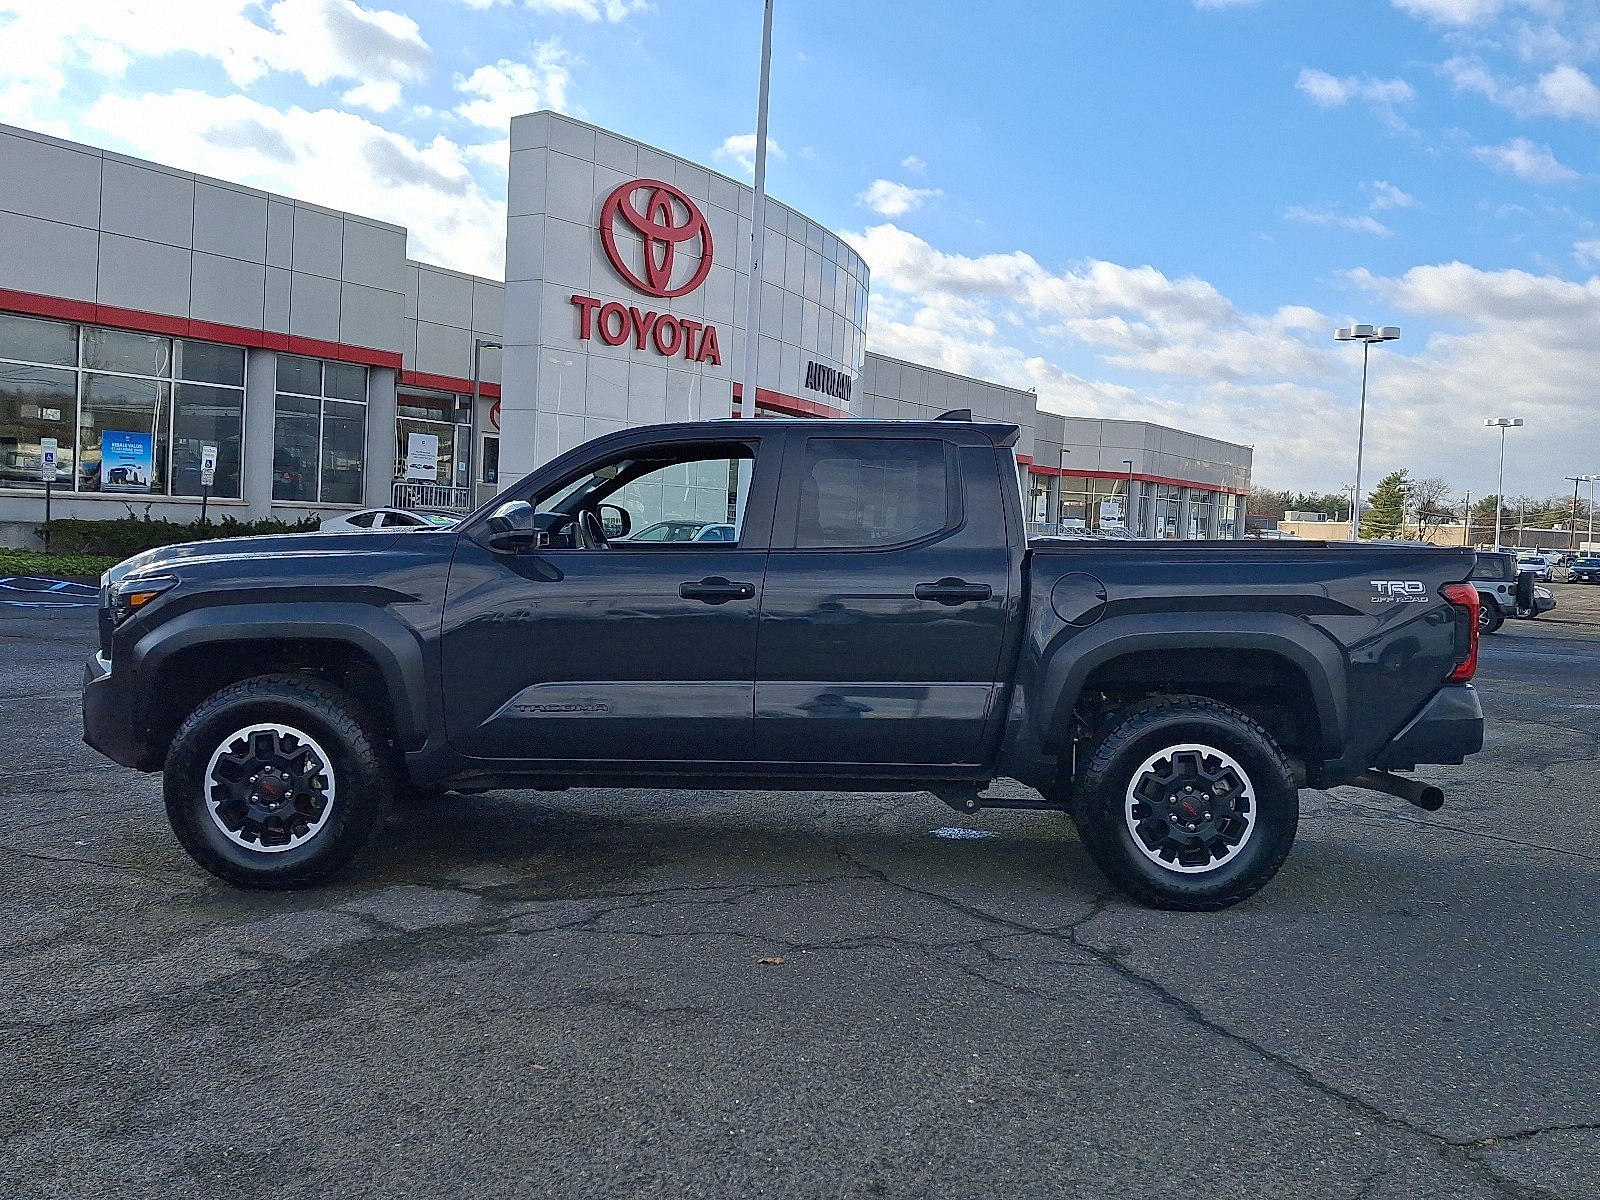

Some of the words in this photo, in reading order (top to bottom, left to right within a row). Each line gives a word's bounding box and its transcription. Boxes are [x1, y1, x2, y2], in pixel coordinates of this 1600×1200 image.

[570, 294, 722, 366] TOYOTA
[1370, 580, 1427, 597] TRD
[514, 703, 609, 713] TACOMA
